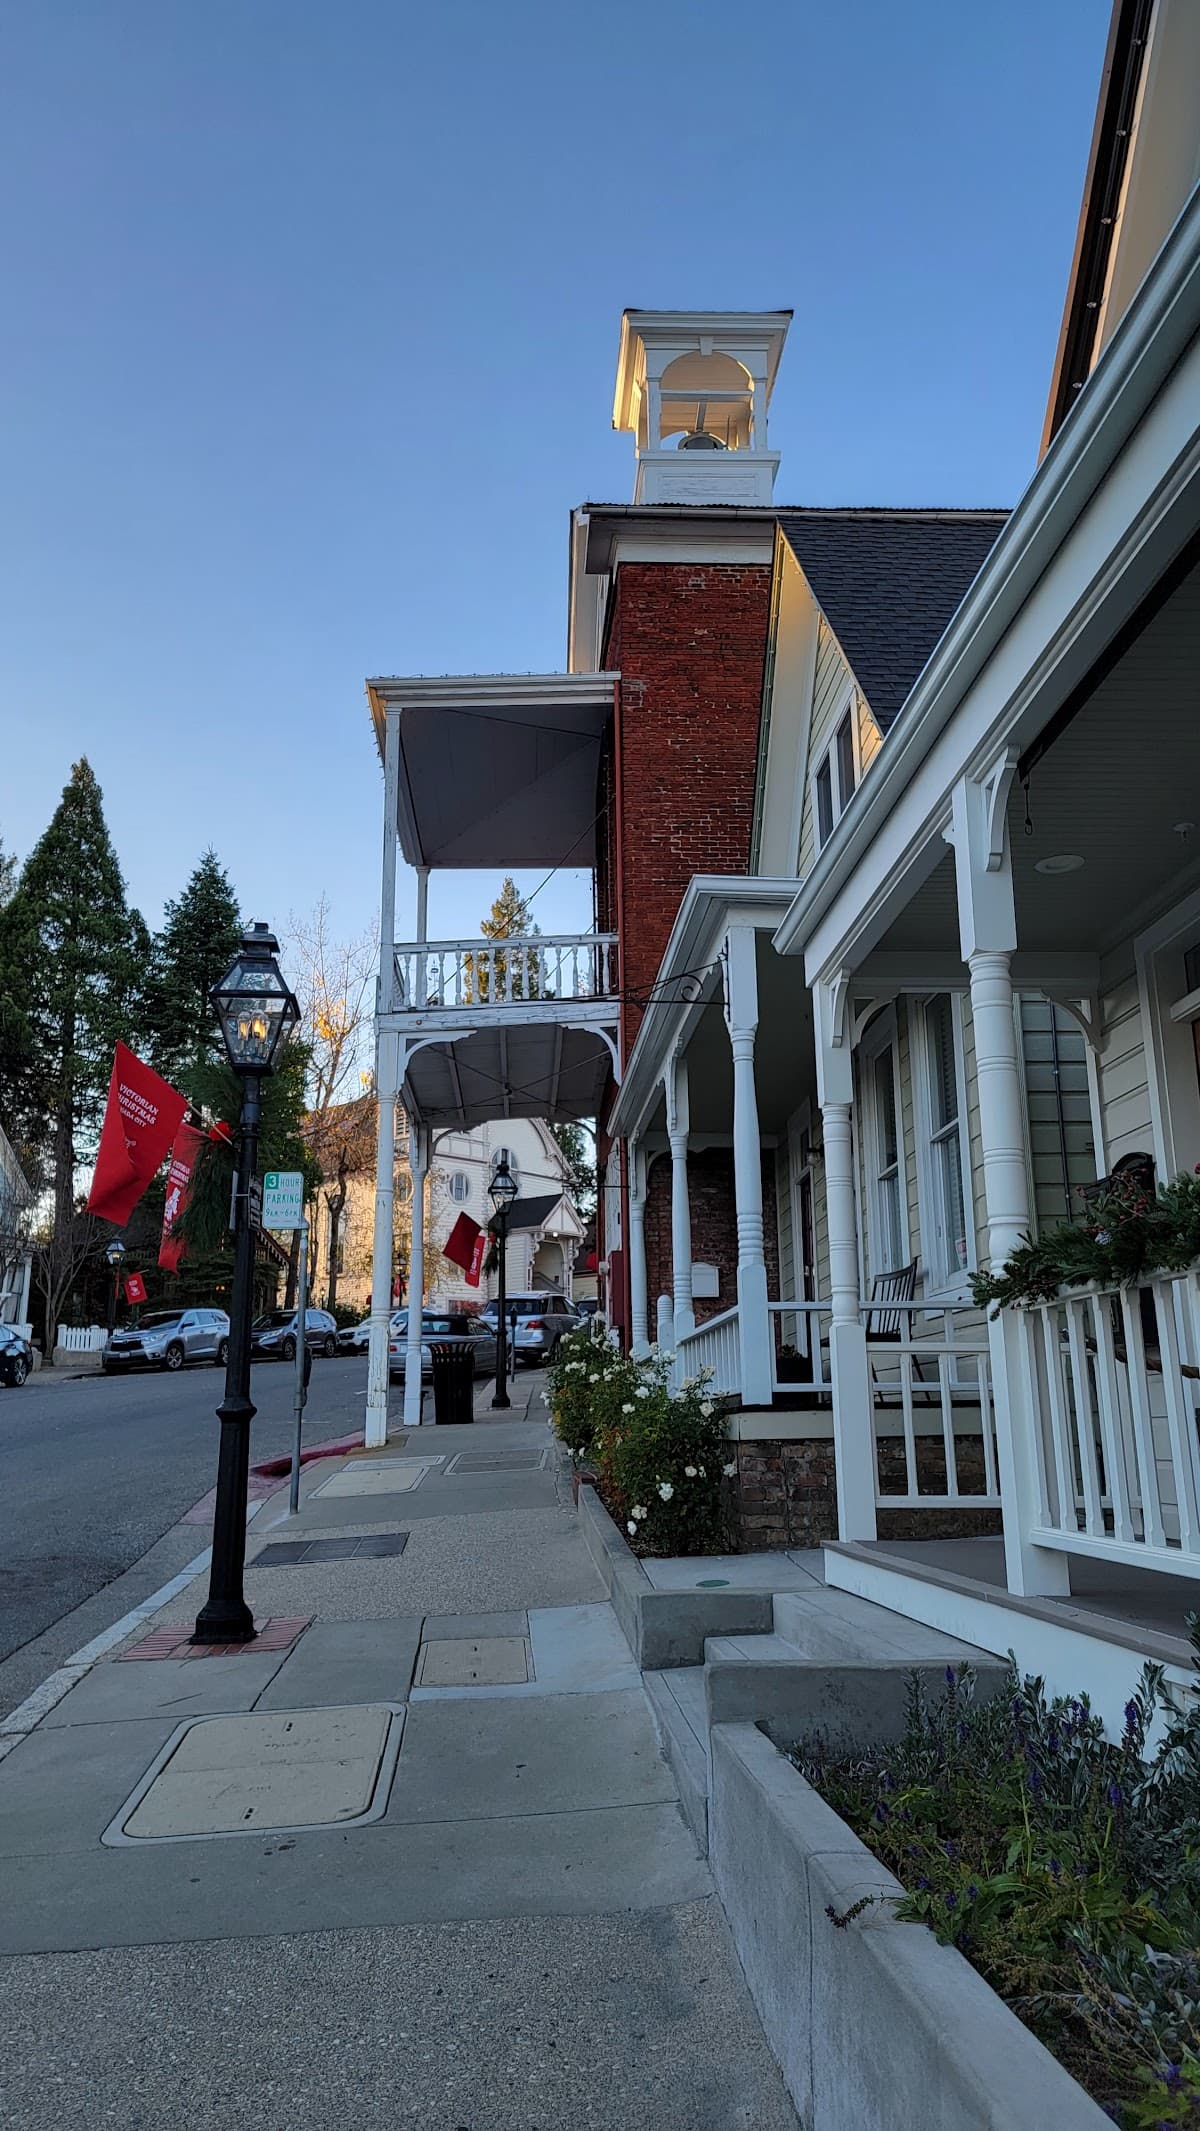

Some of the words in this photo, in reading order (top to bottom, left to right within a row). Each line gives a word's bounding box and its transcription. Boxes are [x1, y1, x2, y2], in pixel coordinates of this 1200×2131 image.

[120, 1083, 159, 1115] VICTORIAN
[134, 1116, 146, 1127] CITY
[268, 1175, 277, 1188] 3
[281, 1178, 301, 1188] HOUR
[266, 1193, 300, 1204] PARKING
